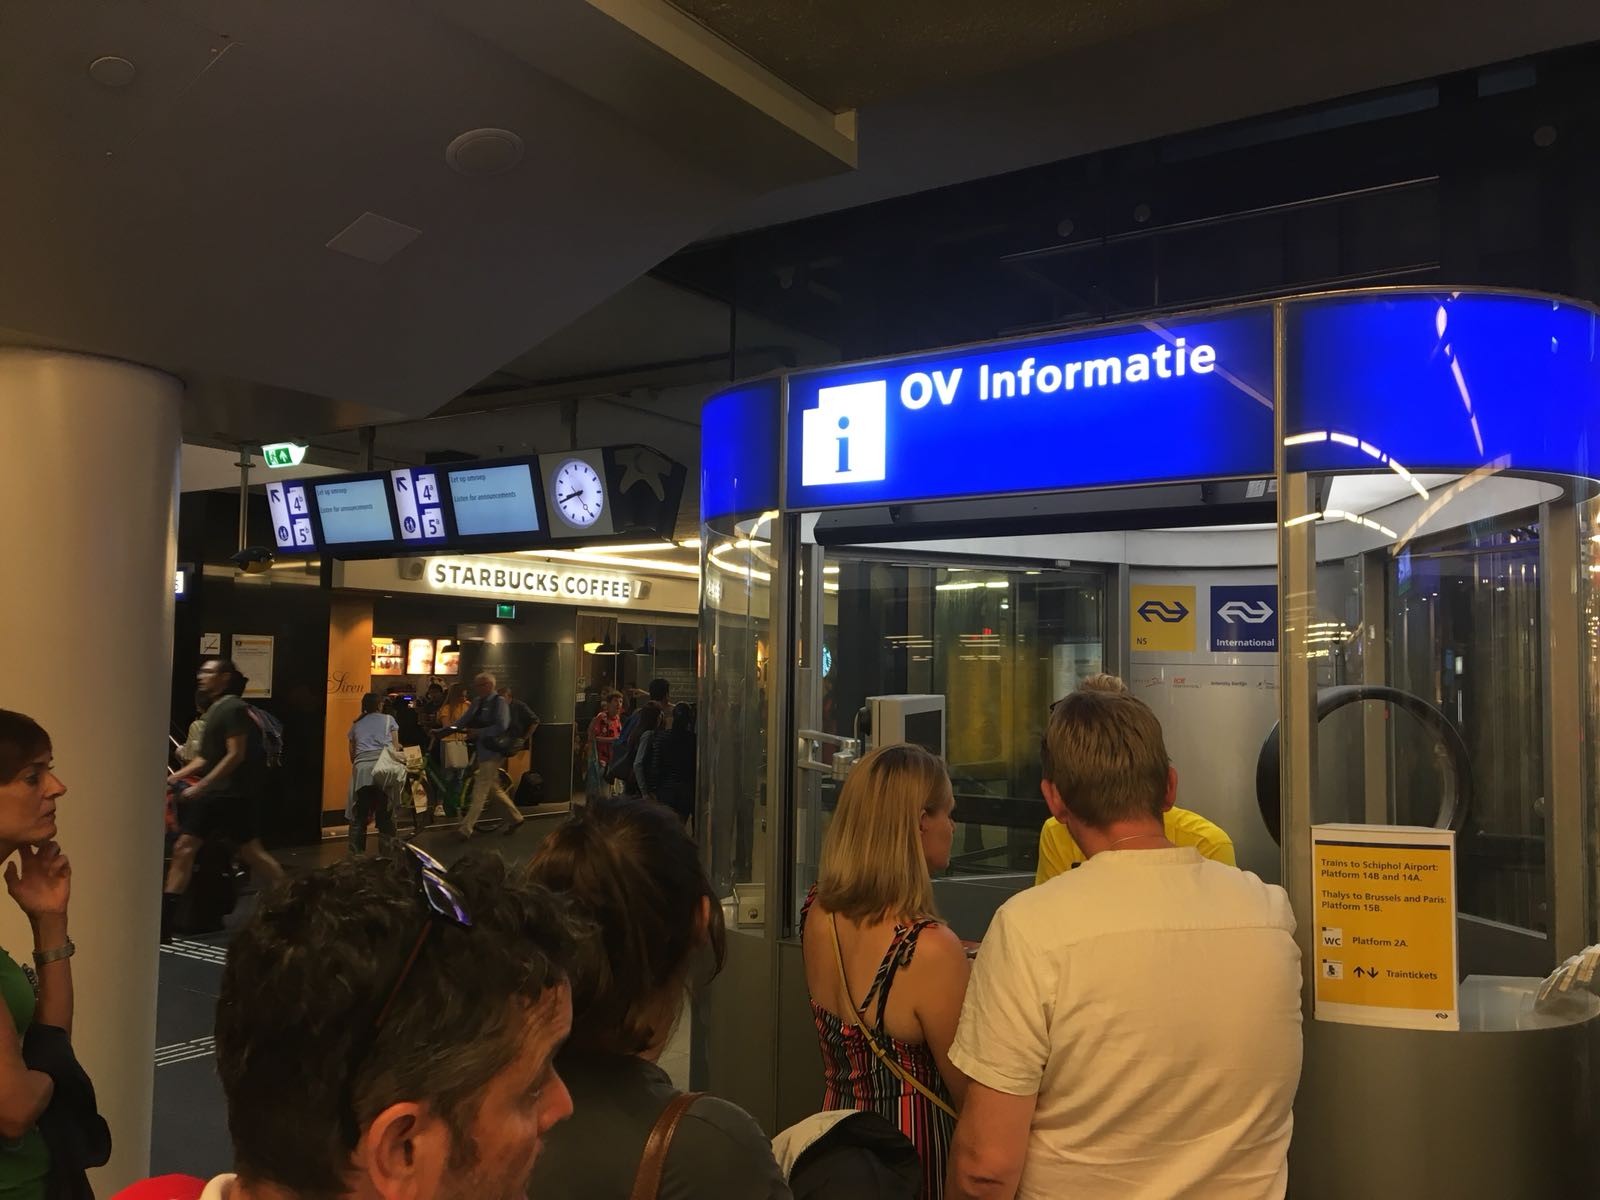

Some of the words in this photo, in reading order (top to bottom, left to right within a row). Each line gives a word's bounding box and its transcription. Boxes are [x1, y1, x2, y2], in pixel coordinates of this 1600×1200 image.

[900, 368, 963, 410] OV
[979, 338, 1216, 400] Informatie
[453, 495, 469, 503] Listen
[478, 491, 516, 500] announcements
[435, 563, 559, 592] STARBUCKS
[565, 576, 630, 598] COFFEE
[1136, 637, 1147, 645] NS
[1216, 638, 1275, 647] International
[1321, 858, 1348, 867] Trains
[1350, 860, 1360, 868] to
[1362, 860, 1401, 871] Schiphol
[1404, 862, 1438, 872] Airport:
[1321, 869, 1360, 879] Platform
[1363, 872, 1380, 880] 14B
[1382, 873, 1399, 881] and
[1403, 874, 1422, 882] 14A.
[1321, 889, 1350, 900] Thalys
[1353, 891, 1362, 900] to
[1365, 893, 1401, 903] Brussels
[1404, 894, 1421, 903] and
[1423, 895, 1447, 904] Paris:
[1321, 901, 1360, 911] Platform
[1363, 904, 1383, 912] 15B.
[1324, 937, 1342, 946] WC
[1352, 936, 1392, 947] Platform
[1394, 939, 1408, 947] 2A.
[1386, 969, 1438, 980] Traintickets
